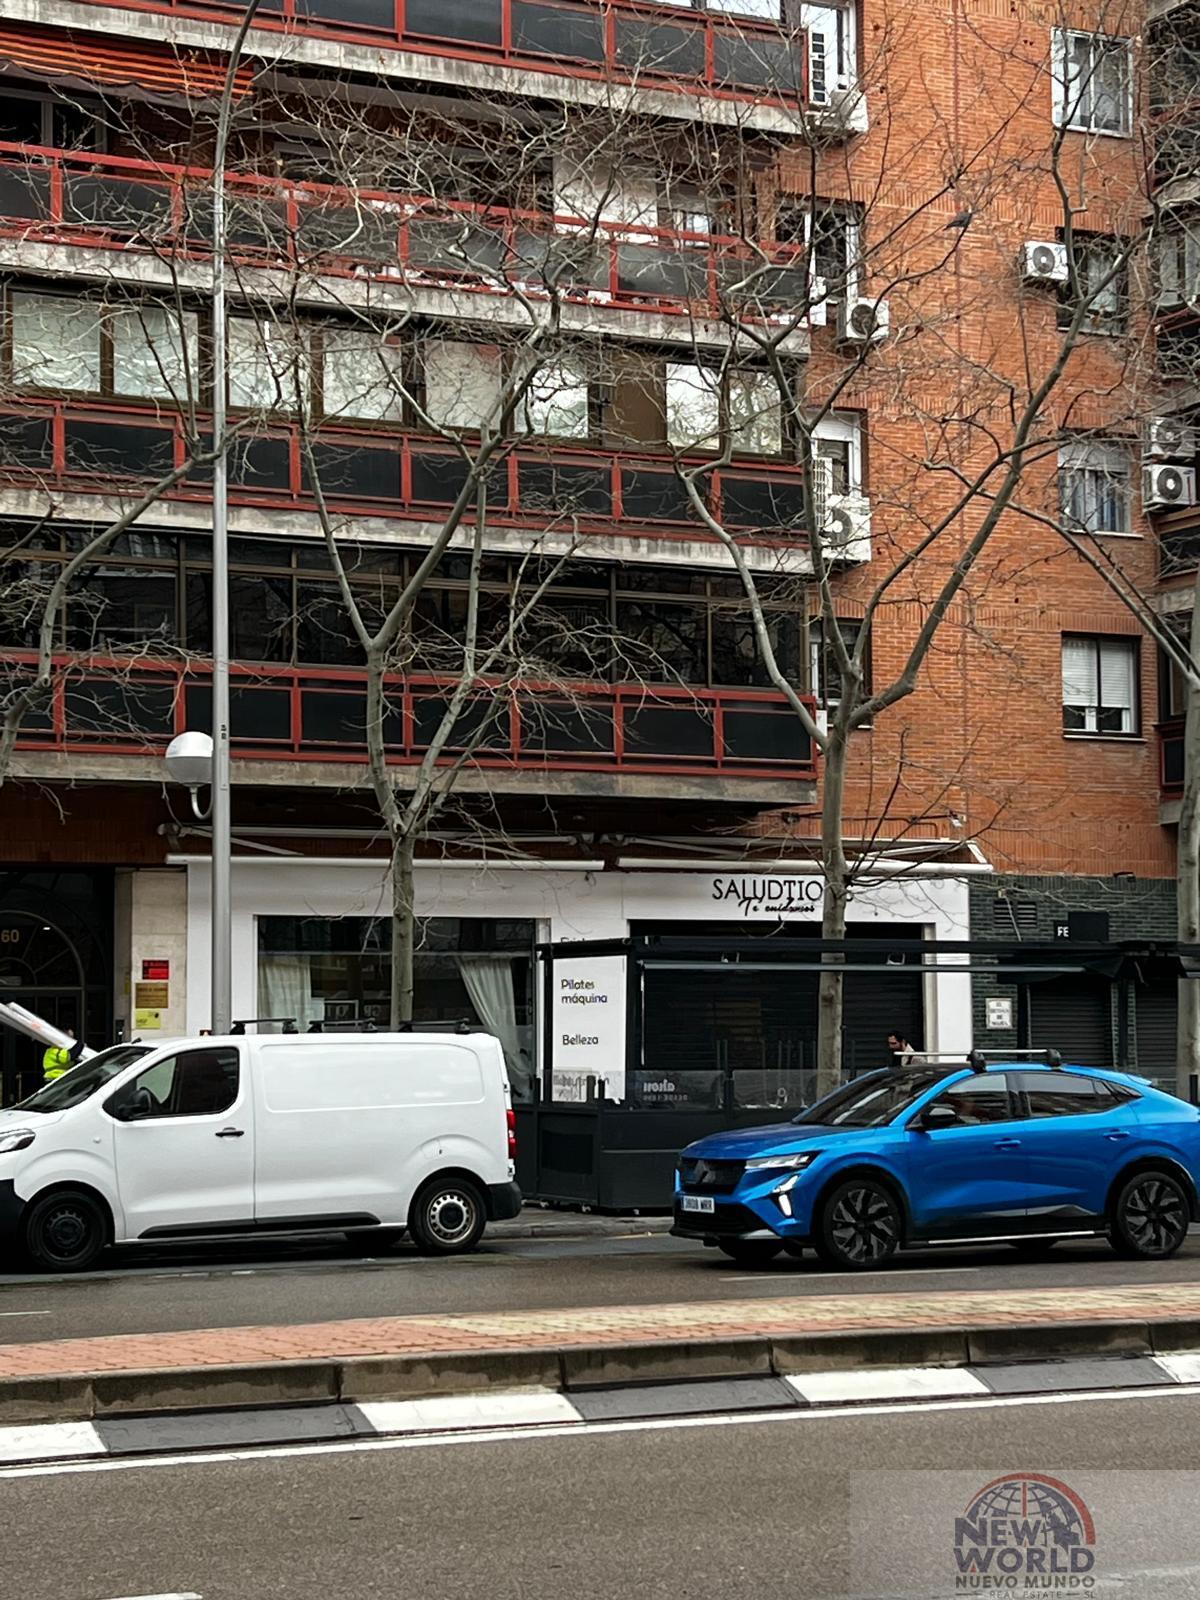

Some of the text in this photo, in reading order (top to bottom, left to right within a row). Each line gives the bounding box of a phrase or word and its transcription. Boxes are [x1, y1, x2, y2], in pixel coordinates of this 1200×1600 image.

[1, 929, 20, 943] 60
[561, 979, 595, 990] Pilates
[561, 993, 608, 1005] máquina
[562, 1034, 599, 1045] Belleza
